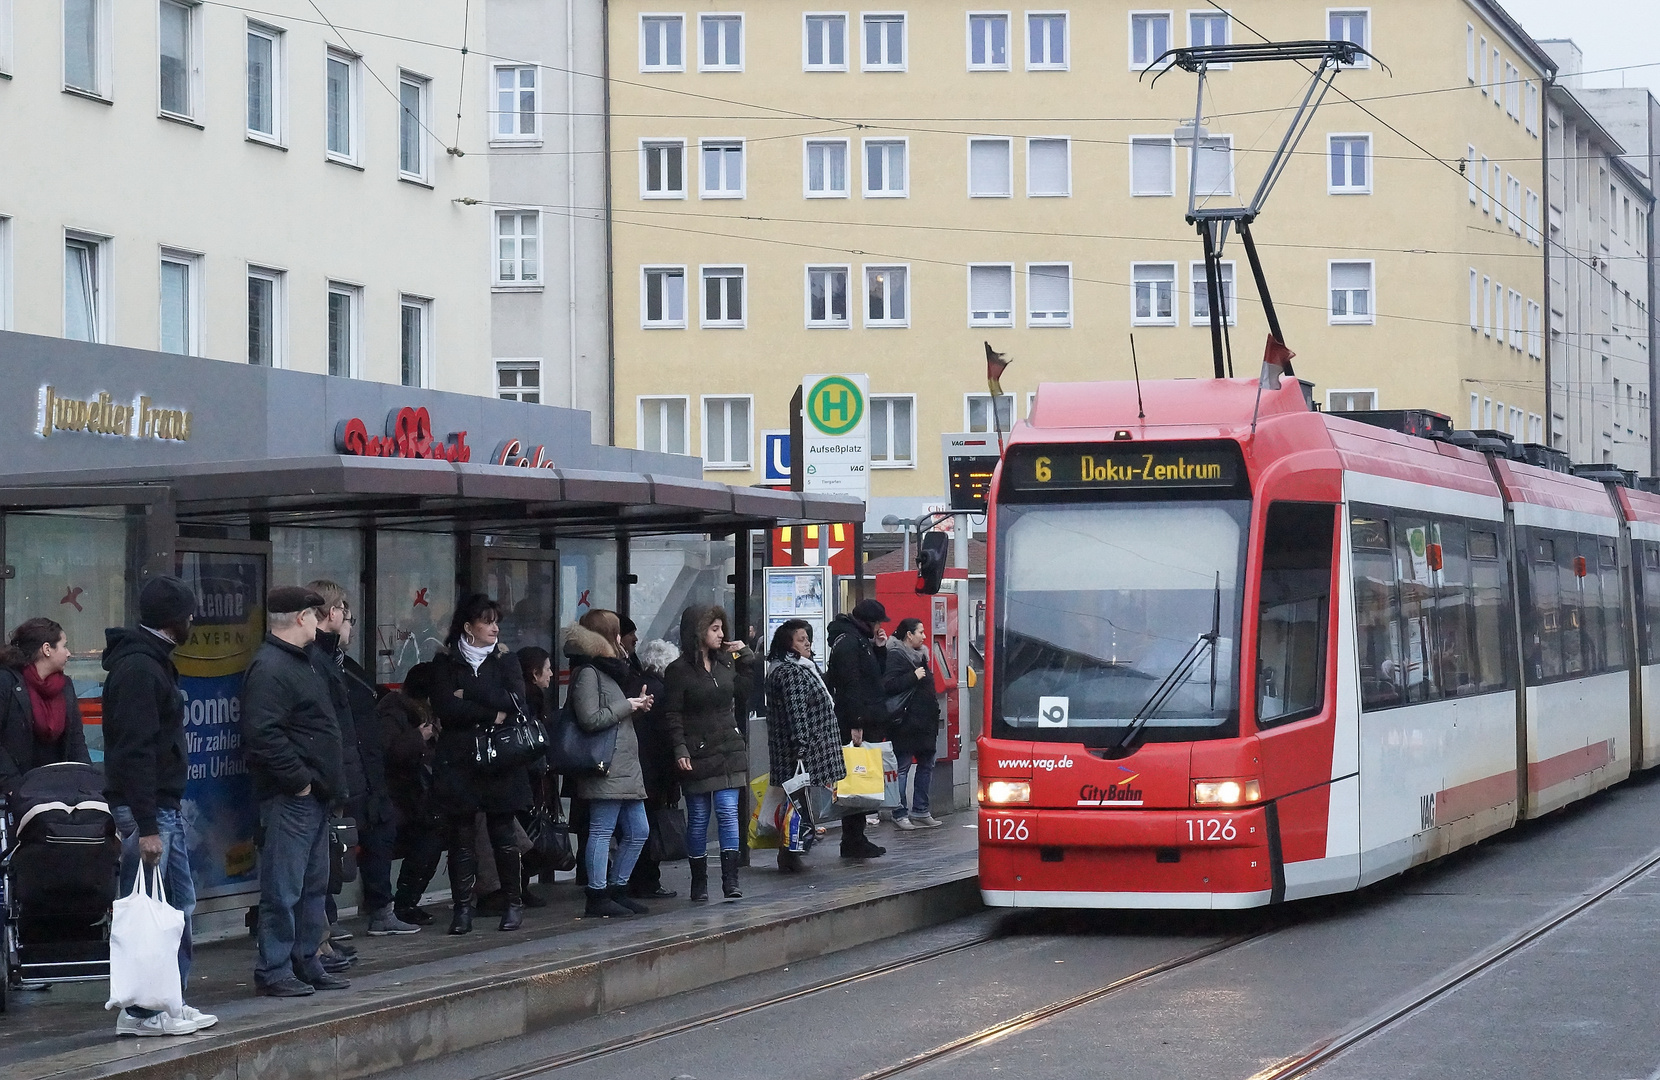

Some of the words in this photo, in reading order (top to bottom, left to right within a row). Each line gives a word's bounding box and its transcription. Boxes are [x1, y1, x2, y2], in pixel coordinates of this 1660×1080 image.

[822, 390, 848, 421] H
[809, 445, 862, 455] Aufseßplatz
[1035, 456, 1052, 482] 6
[1081, 455, 1221, 481] Doku-Zentrum
[194, 593, 243, 618] tenne
[189, 631, 244, 645] AYERN
[187, 763, 206, 780] ren
[998, 755, 1074, 771] www.vag.de
[986, 818, 1029, 841] 1126
[1185, 818, 1237, 841] 1126
